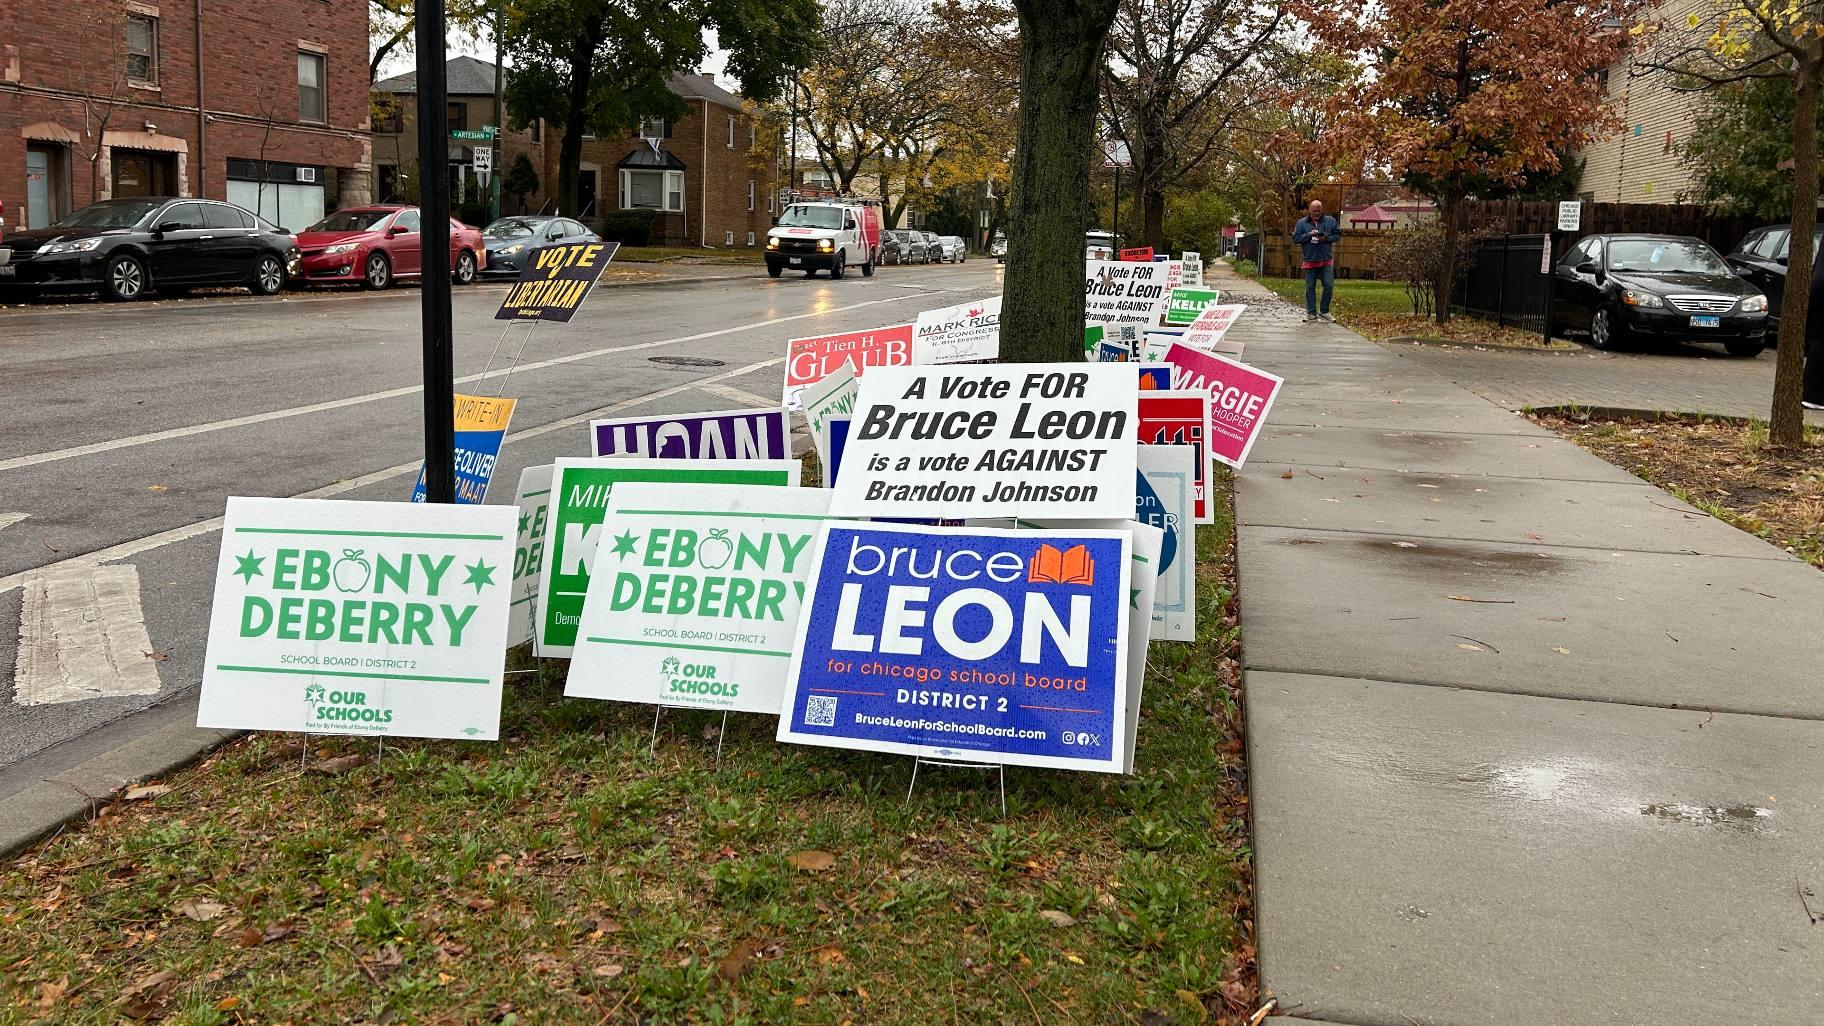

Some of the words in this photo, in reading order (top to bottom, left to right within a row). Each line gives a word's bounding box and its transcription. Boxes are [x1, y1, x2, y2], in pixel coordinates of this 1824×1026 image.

[458, 131, 485, 139] ARTESIAN
[535, 245, 604, 274] VOTE
[1097, 266, 1104, 277] A
[1108, 267, 1129, 278] Vote
[1132, 267, 1153, 279] FOR
[504, 280, 589, 309] LIBERTARIAN
[1085, 279, 1124, 296] Bruce
[1127, 281, 1162, 298] Leon
[1100, 301, 1114, 309] vote
[1115, 301, 1154, 311] AGAINST
[919, 319, 967, 334] MARK
[1085, 312, 1115, 321] Brandon
[1117, 314, 1149, 324] Johnson
[822, 340, 856, 353] Tien
[861, 335, 879, 348] H.
[925, 334, 944, 342] FOR
[947, 326, 1000, 338] CONGRESS
[957, 335, 990, 343] DISTRICT
[790, 341, 908, 380] GLAUB
[901, 376, 927, 400] A
[939, 376, 1010, 400] Vote
[1019, 372, 1089, 400] FOR
[1173, 366, 1264, 420] MAGGIE
[457, 399, 505, 425] WRITE-IN
[857, 404, 998, 440] Bruce
[1009, 403, 1127, 440] Leon
[1213, 407, 1250, 429] HOOPER
[613, 415, 769, 459] HOAN
[1217, 427, 1244, 442] Education
[461, 450, 495, 478] OLIVER
[867, 452, 890, 472] is
[894, 456, 911, 472] a
[919, 452, 970, 472] vote
[974, 448, 1107, 472] AGAINST
[568, 484, 612, 508] MIK
[865, 480, 976, 502] Brandon
[982, 481, 1098, 502] Johnson
[846, 536, 1023, 582] bruce
[239, 596, 478, 647] DEBERRY
[555, 612, 581, 626] Demo
[831, 582, 1091, 667] LEON
[643, 628, 678, 638] SCHOOL
[680, 630, 712, 641] BOARD
[719, 633, 759, 643] DISTRICT
[760, 635, 766, 644] 2
[280, 654, 320, 665] SCHOOL
[323, 656, 358, 667] BOARD
[365, 658, 408, 669] DISTRICT
[410, 660, 417, 669] 2
[682, 664, 716, 679] OUR
[827, 658, 853, 674] for
[860, 660, 942, 683] chicago
[950, 668, 1015, 685] school
[1025, 673, 1087, 691] board
[329, 691, 366, 705] OUR
[670, 679, 739, 697] SCHOOLS
[896, 688, 989, 711] DISTRICT
[997, 697, 1008, 712] 2
[317, 706, 393, 722] SCHOOLS
[855, 712, 1046, 740] BruceLeonForSchoolBoard.com
